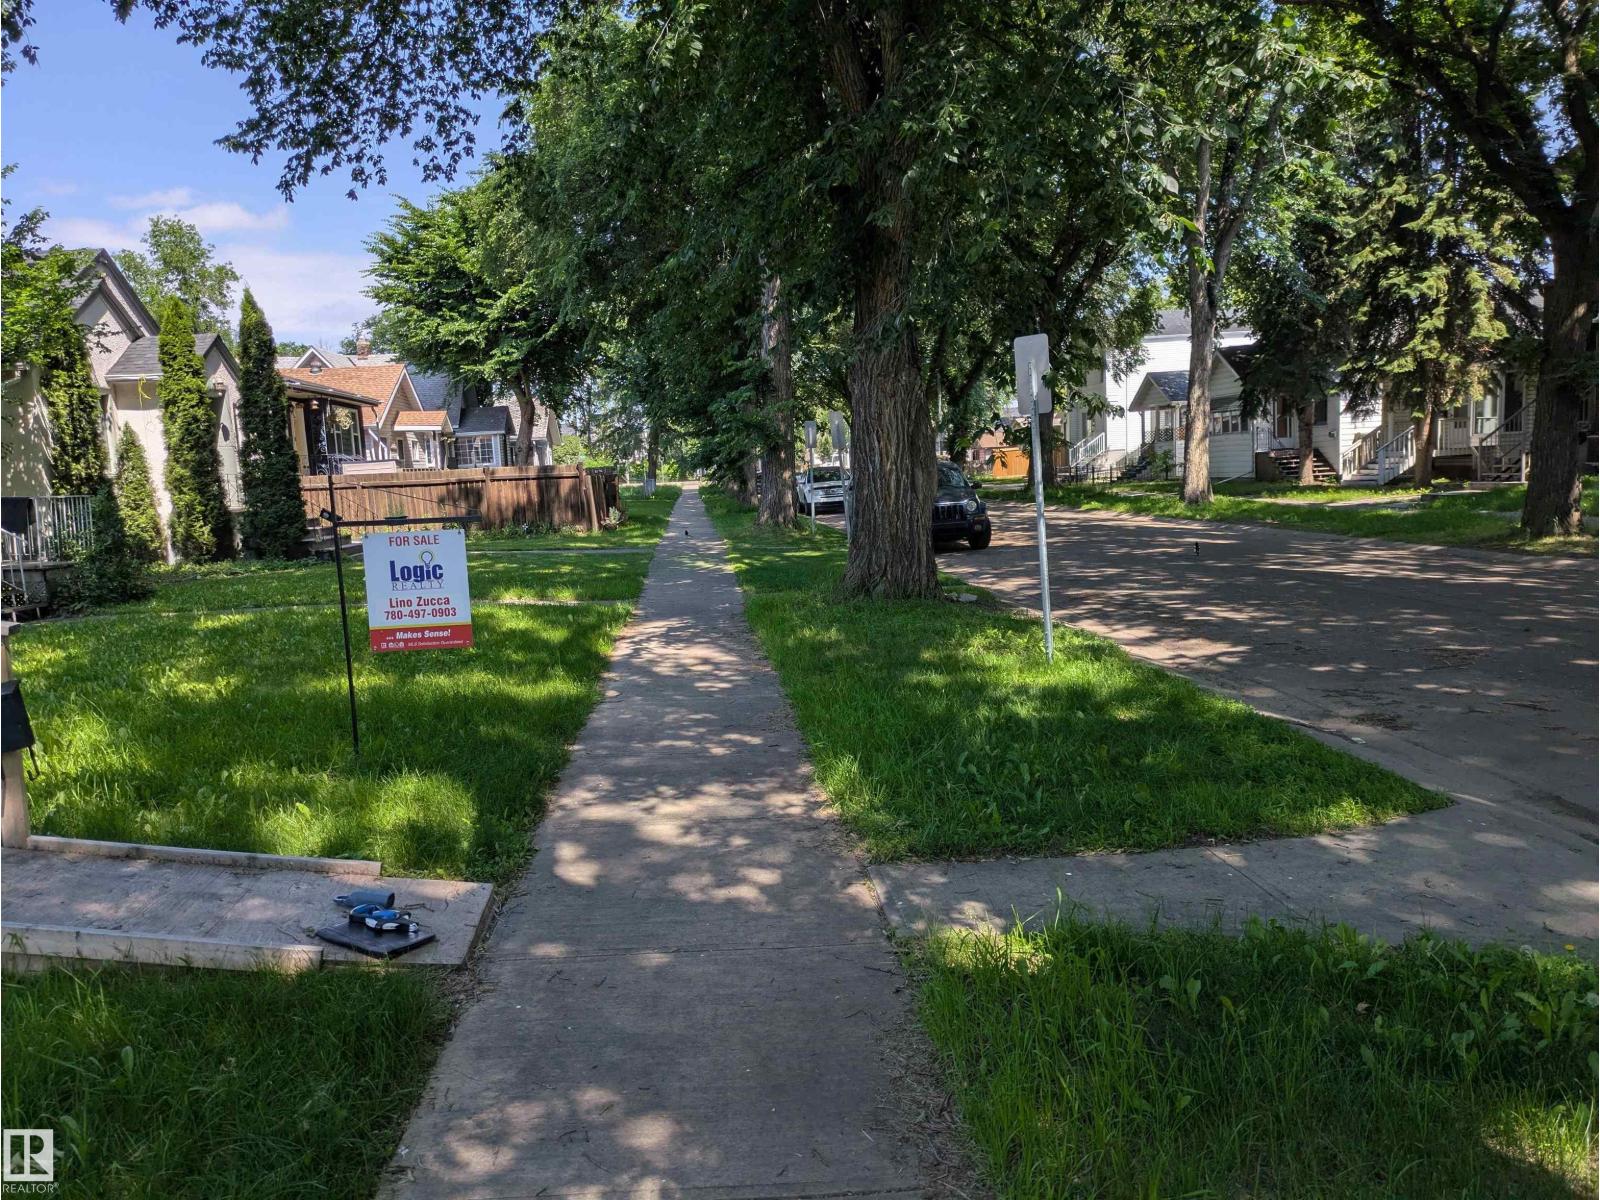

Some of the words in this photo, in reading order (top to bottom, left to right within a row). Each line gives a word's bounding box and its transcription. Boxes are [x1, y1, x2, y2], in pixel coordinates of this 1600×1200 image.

[388, 535, 410, 547] FOR
[413, 534, 440, 546] SALE
[389, 559, 444, 583] Logic
[392, 579, 444, 591] REALTY
[389, 597, 413, 608] Lino
[416, 596, 451, 607] Zucca
[384, 607, 457, 621] 780-497-0903
[396, 631, 422, 640] Makes
[423, 629, 451, 639] Sense!
